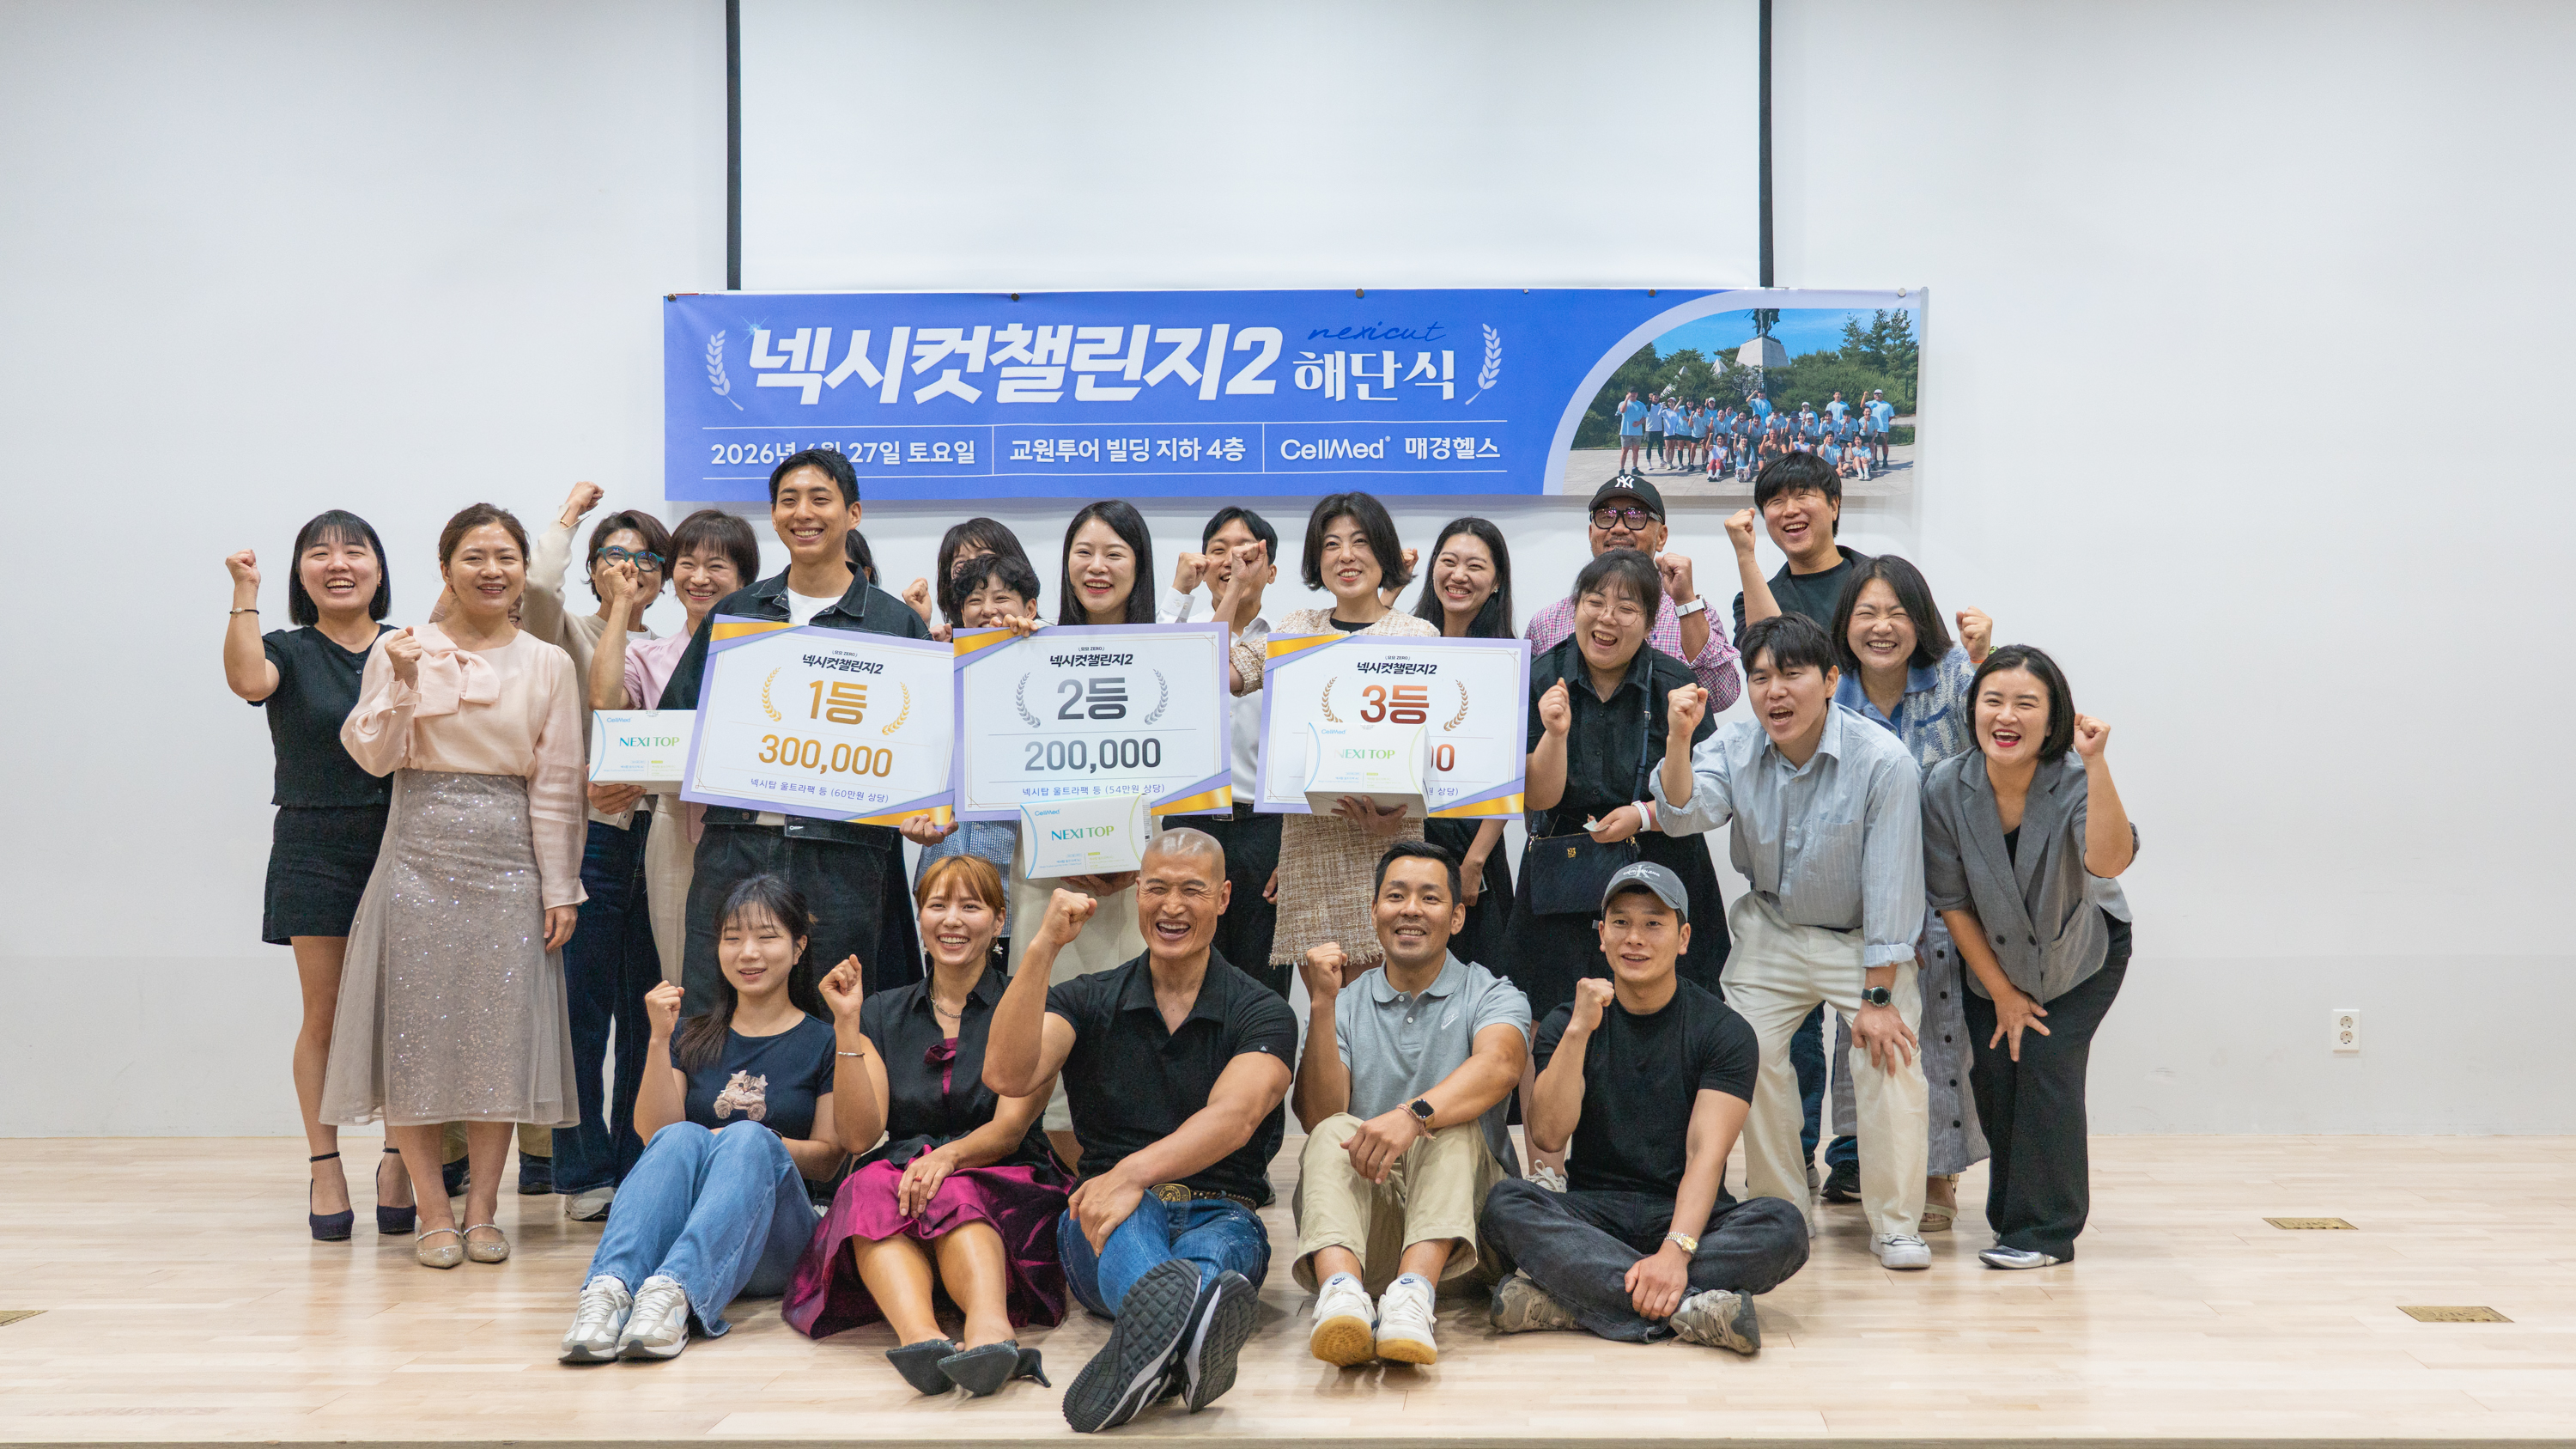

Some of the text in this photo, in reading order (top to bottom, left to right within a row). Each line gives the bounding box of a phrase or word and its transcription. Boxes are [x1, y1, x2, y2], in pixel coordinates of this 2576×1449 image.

[1307, 321, 1446, 342] nexicut
[749, 323, 1283, 405] 넥시컷챌린지2
[1292, 350, 1455, 402] 해단식
[711, 441, 796, 465] 2026년
[848, 441, 900, 465] 27일
[907, 440, 975, 465] 토요일
[1009, 436, 1246, 463] 교원투어 빌딩 지하 4층
[1404, 436, 1501, 460] 매경헬스
[1614, 475, 1635, 489] NY
[802, 654, 884, 675] 넥시컷챌린지2
[1049, 654, 1133, 667] 넥시컷챌린지2
[1357, 662, 1437, 675] 넥시컷챌린지2
[809, 679, 868, 726] 1등
[1056, 677, 1128, 721] 2등
[1360, 685, 1430, 725] 3등
[619, 737, 680, 747] NEXI TOP
[1334, 748, 1396, 760] NEXI TOP
[758, 734, 893, 778] 300,000
[1024, 738, 1161, 774] 200,000
[750, 778, 890, 804] 넥시탑 울트라팩 등 (60만원 상당)
[1022, 783, 1165, 797] 넥시탑 울트라팩 등 (54만원 상당)
[1437, 787, 1459, 797] 상당)
[1051, 825, 1115, 841] NEXI TOP
